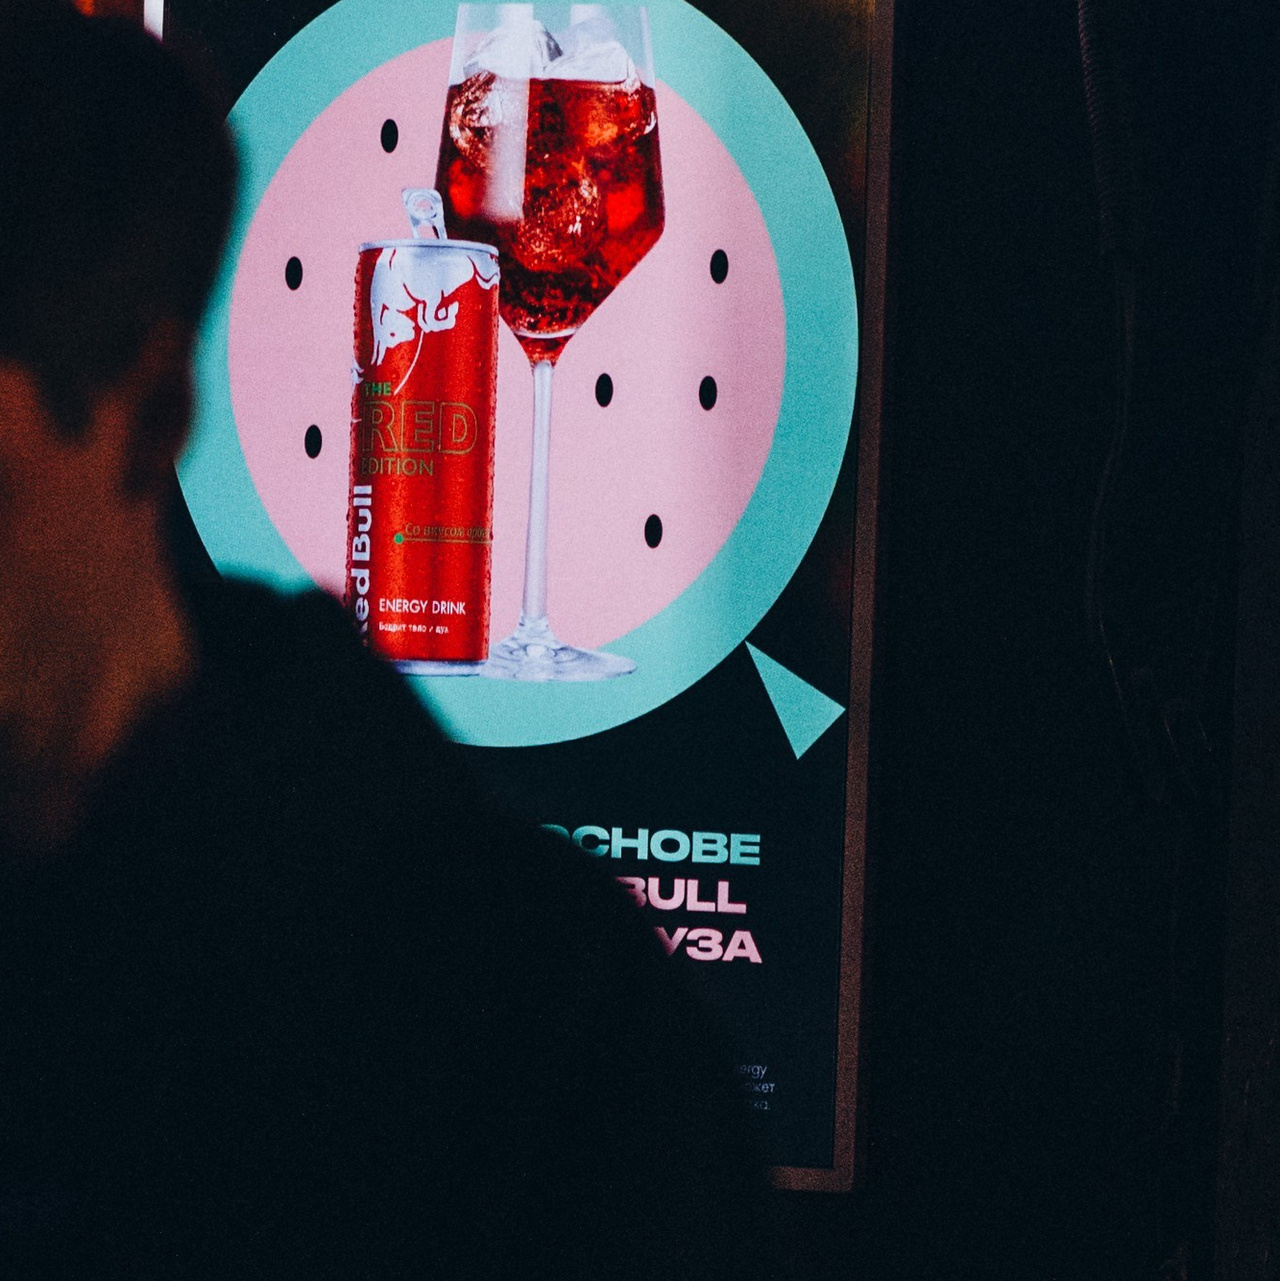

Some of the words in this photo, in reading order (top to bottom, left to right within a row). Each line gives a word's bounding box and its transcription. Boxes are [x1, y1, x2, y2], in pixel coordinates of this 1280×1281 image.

[365, 381, 392, 396] THE
[362, 400, 478, 455] RED
[360, 457, 434, 476] EDITION
[352, 485, 372, 562] Bull
[351, 568, 370, 634] ed
[378, 597, 428, 614] ENERGY
[432, 600, 466, 615] DRINK
[539, 824, 761, 866] СНОВЕ
